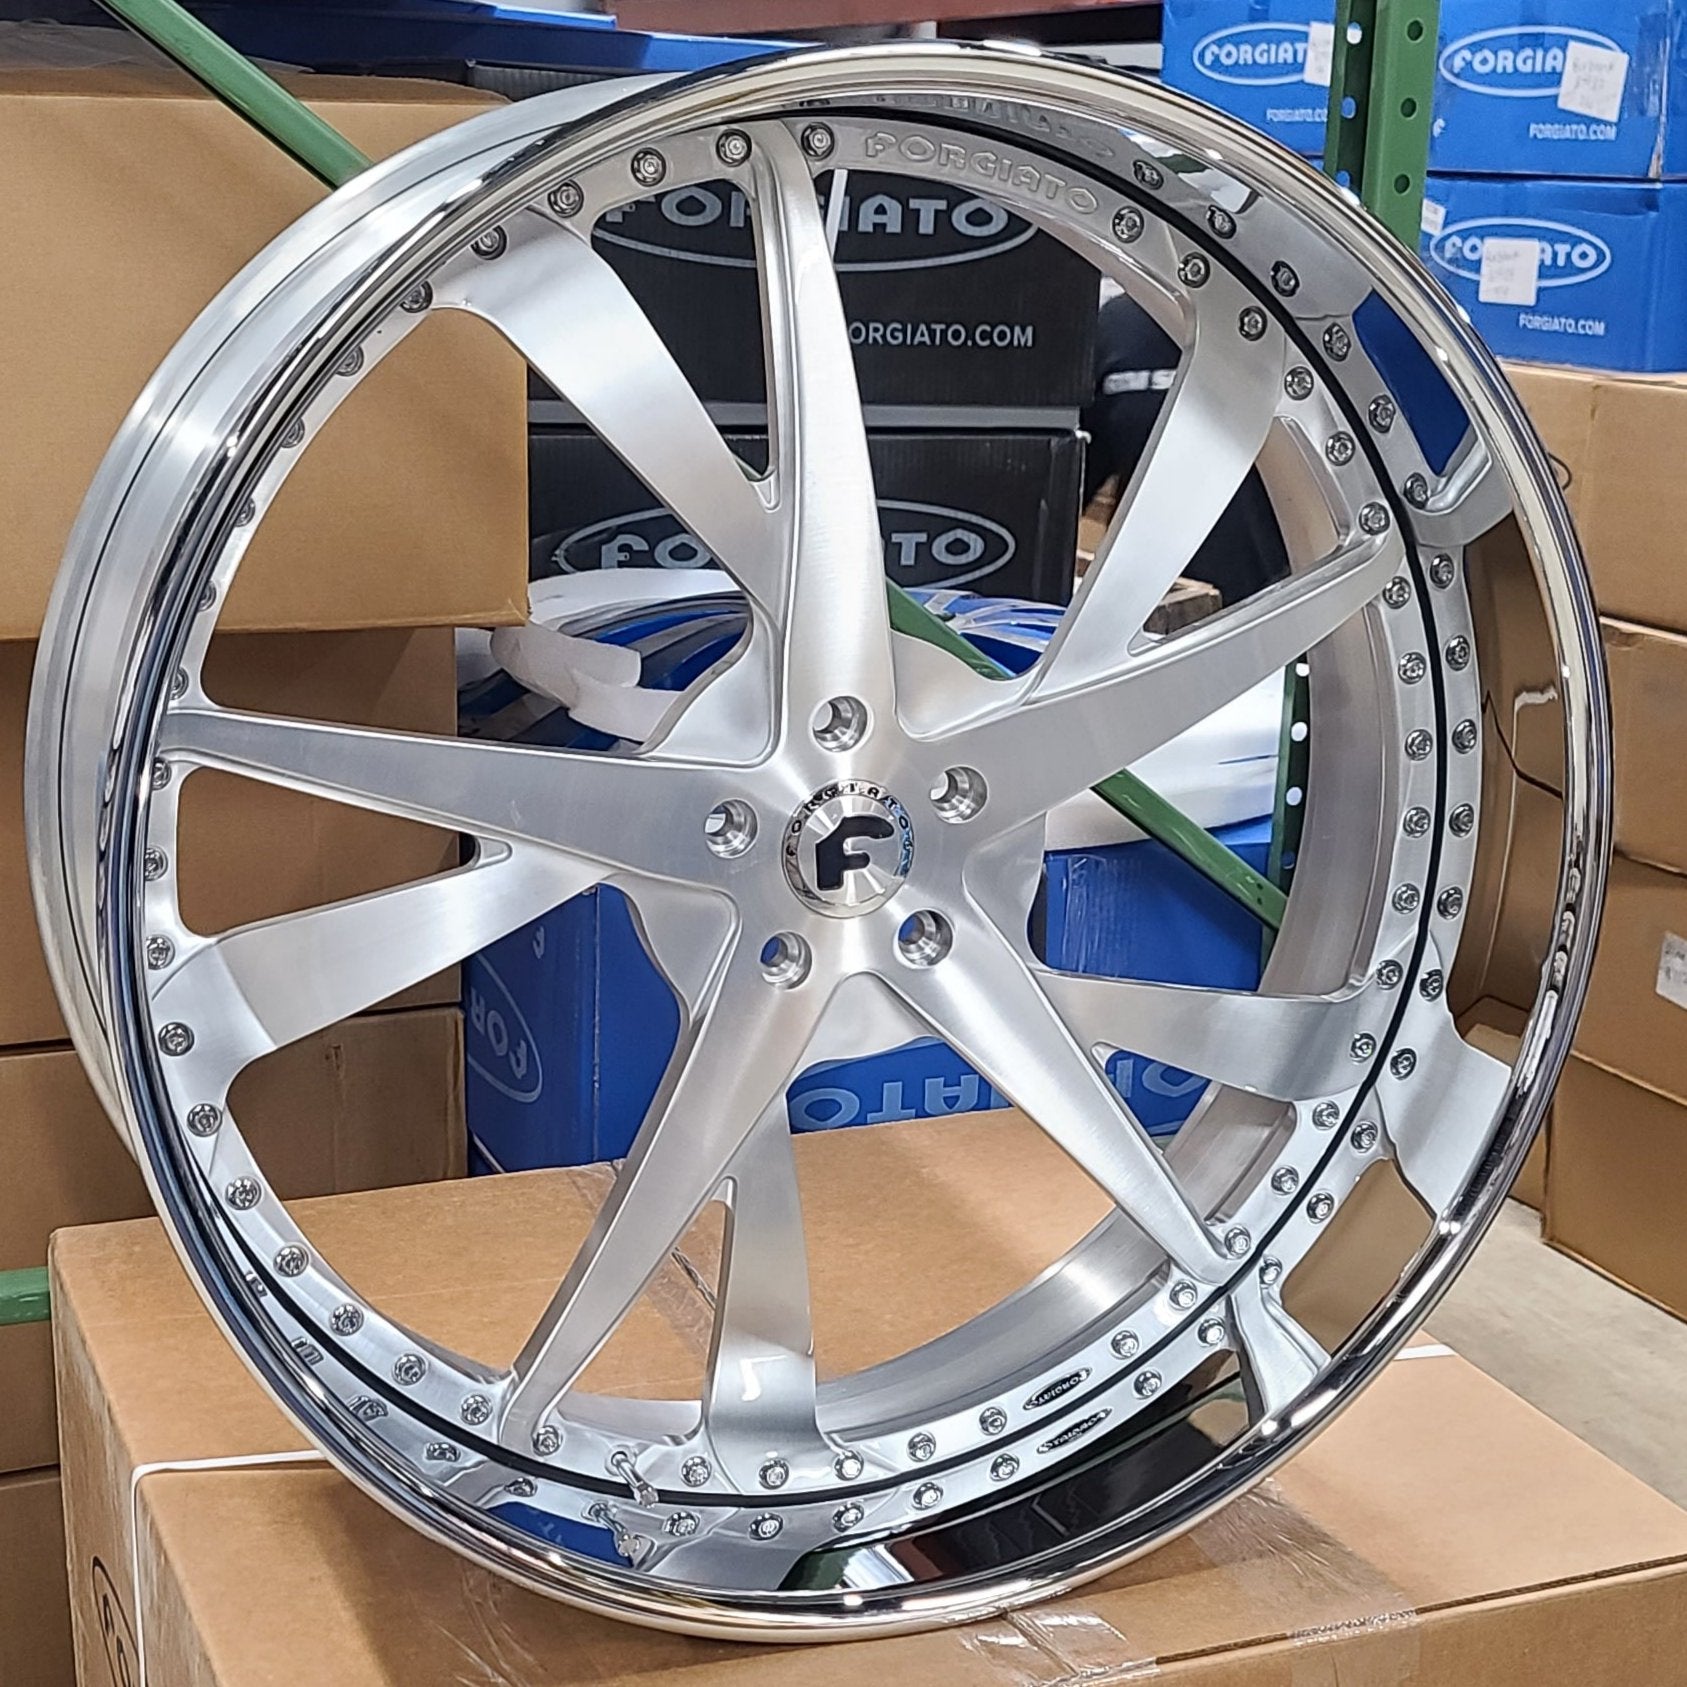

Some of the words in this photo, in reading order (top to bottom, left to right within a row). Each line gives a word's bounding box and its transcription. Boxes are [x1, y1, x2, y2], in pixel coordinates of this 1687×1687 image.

[1203, 41, 1307, 67] FORGIAT
[1452, 46, 1564, 75] FORGIA
[1265, 107, 1328, 123] FORGIATO.CO
[1528, 121, 1618, 141] FORGIATO.COM
[864, 131, 1099, 214] FORGIATO
[1444, 235, 1598, 269] FOATO
[849, 321, 1034, 348] ORGIATO.COM
[1518, 311, 1606, 337] FORGIATO.COM
[815, 815, 895, 891] F
